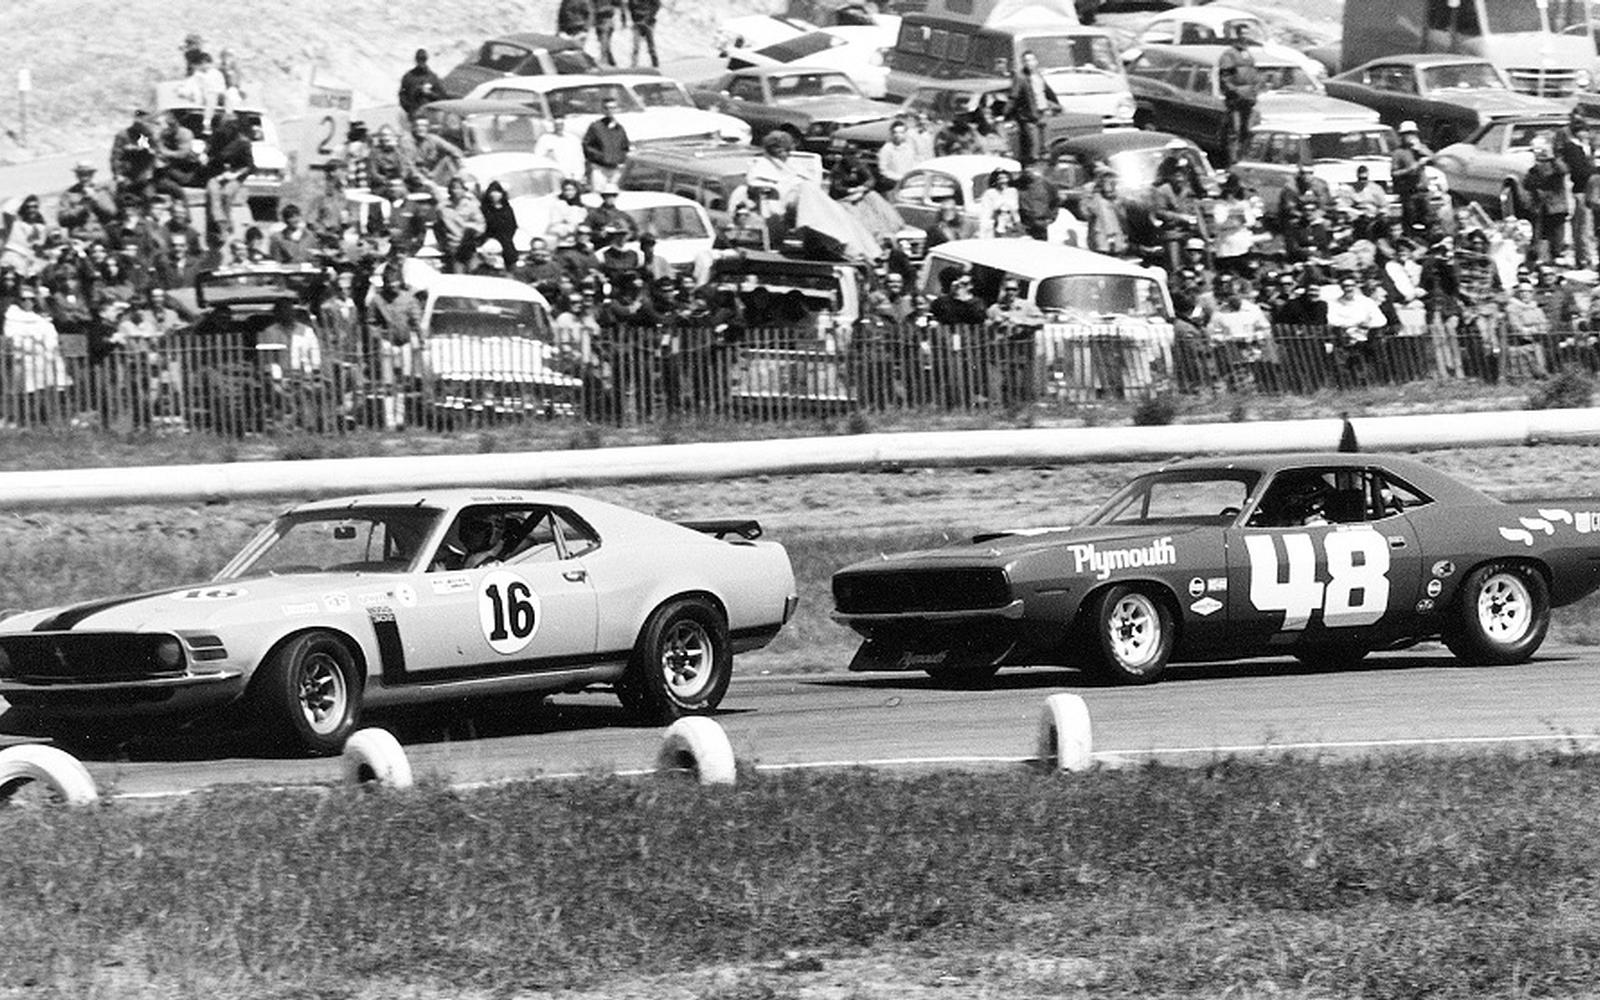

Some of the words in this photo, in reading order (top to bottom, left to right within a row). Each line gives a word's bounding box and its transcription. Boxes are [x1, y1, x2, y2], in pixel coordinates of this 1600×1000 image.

[318, 115, 335, 154] 2
[1067, 537, 1176, 580] Plymouth
[1244, 531, 1391, 631] 48
[486, 581, 535, 641] 16
